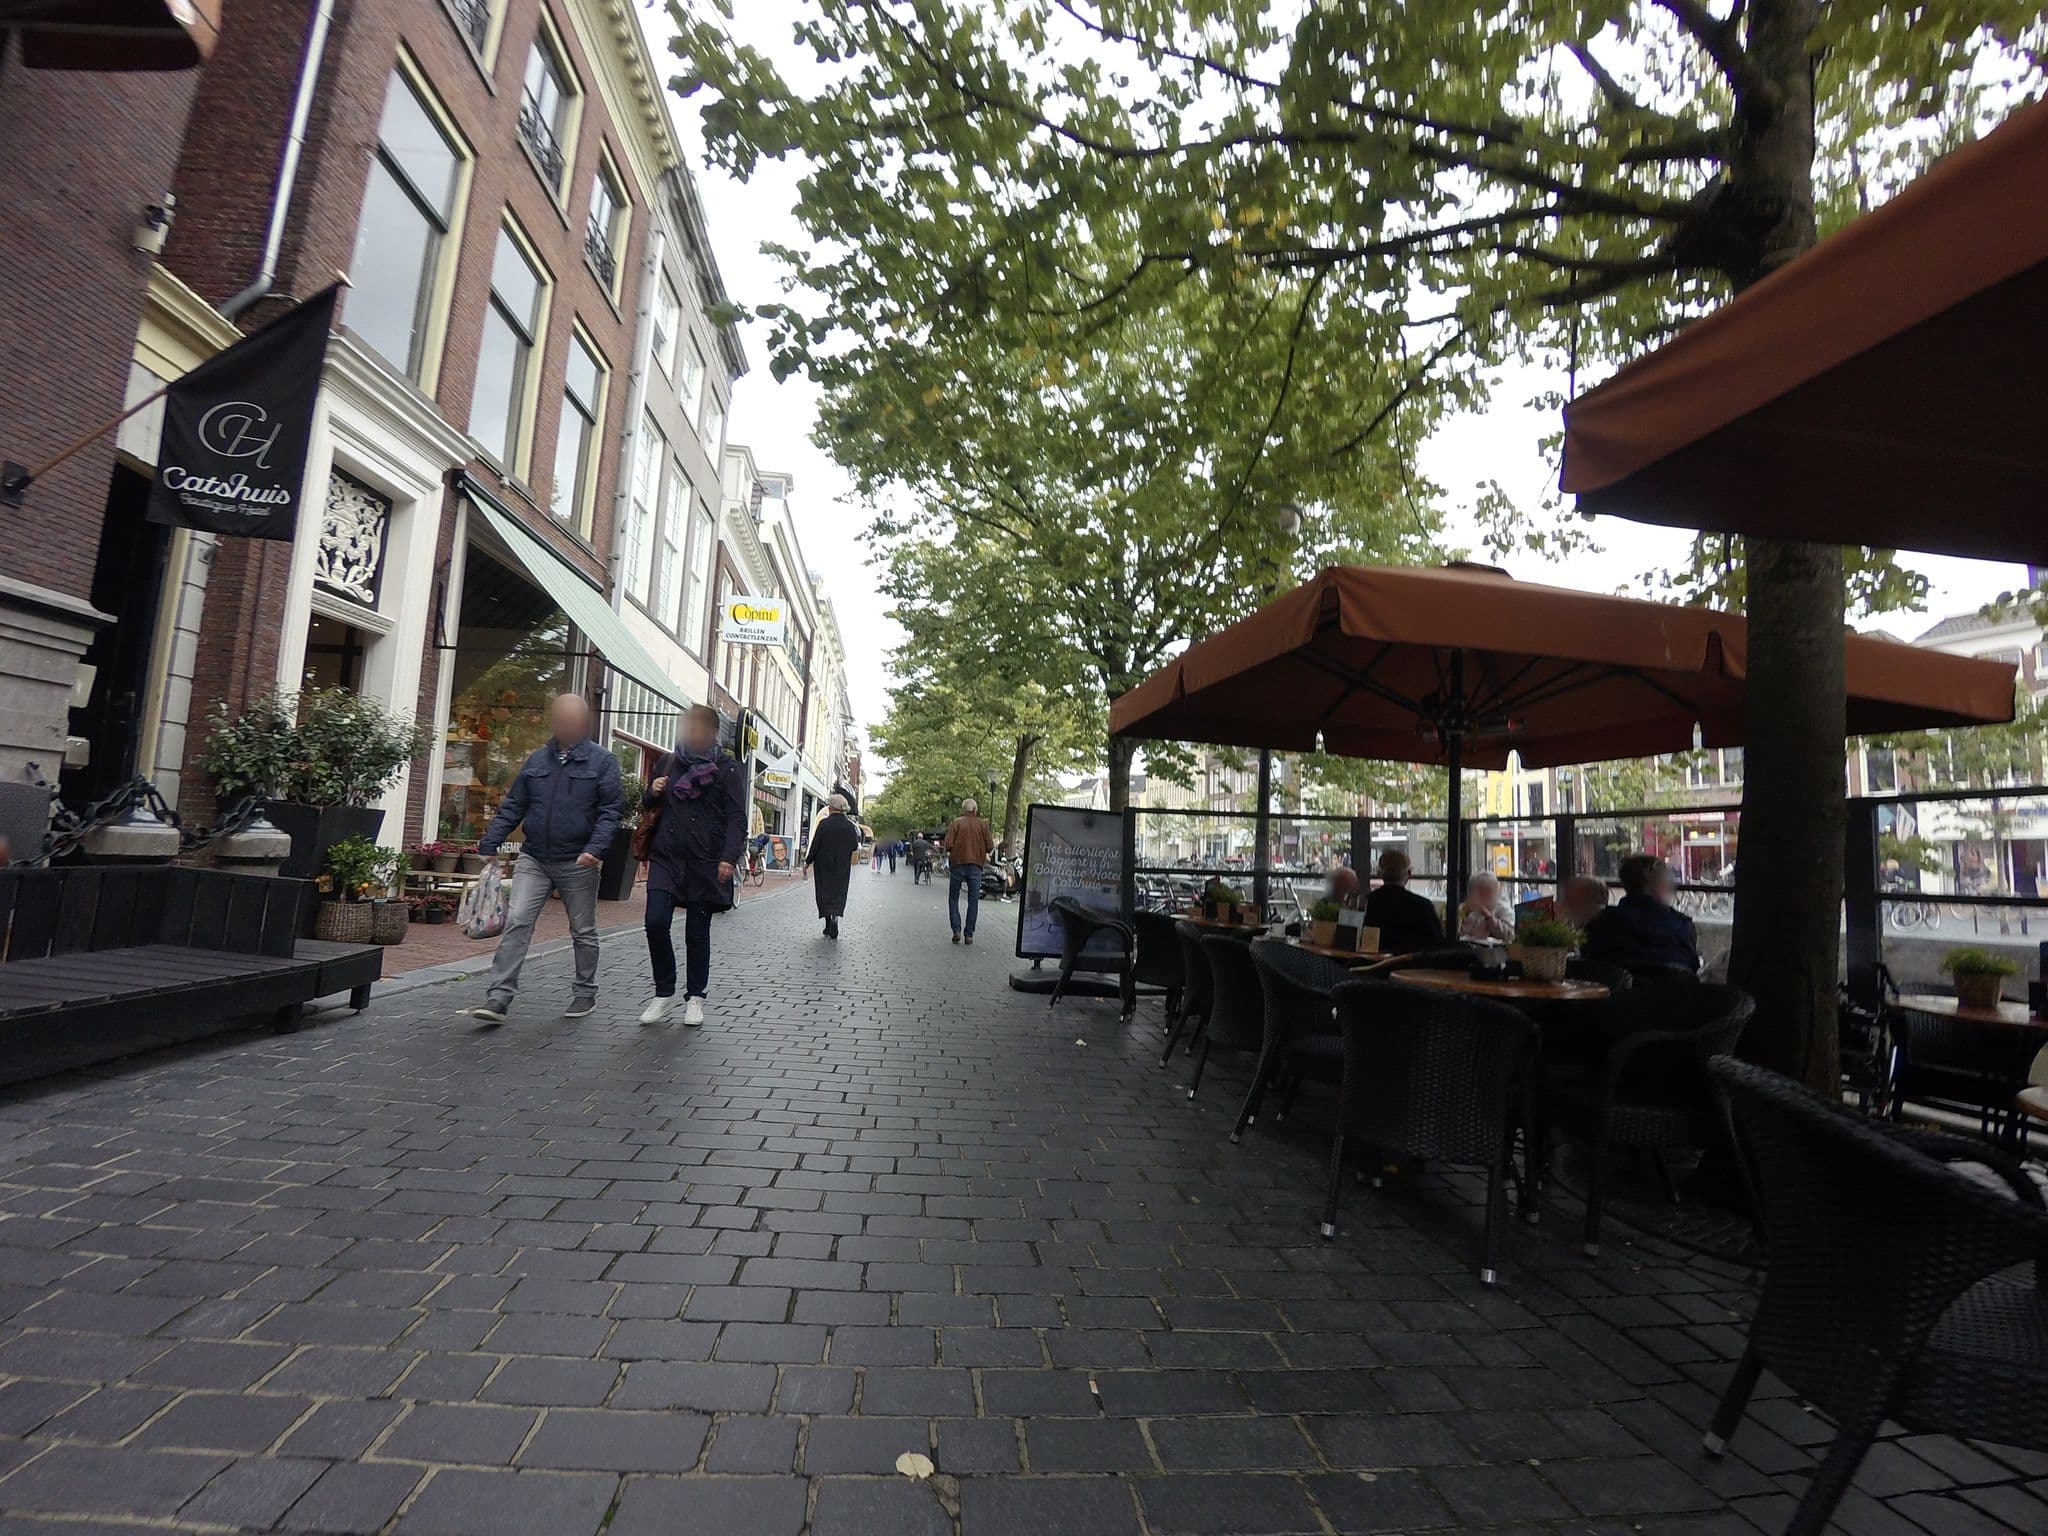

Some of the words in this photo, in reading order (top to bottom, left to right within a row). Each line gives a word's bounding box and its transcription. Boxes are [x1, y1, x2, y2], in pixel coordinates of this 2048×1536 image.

[163, 466, 291, 505] Catshuis
[732, 603, 773, 625] Copini
[725, 632, 778, 642] CONTACTLENZEN
[739, 627, 766, 635] BRILLEN
[1040, 841, 1062, 855] Het
[1046, 853, 1088, 869] logeert
[1033, 863, 1087, 879] Boutique
[1090, 868, 1122, 881] Hotel
